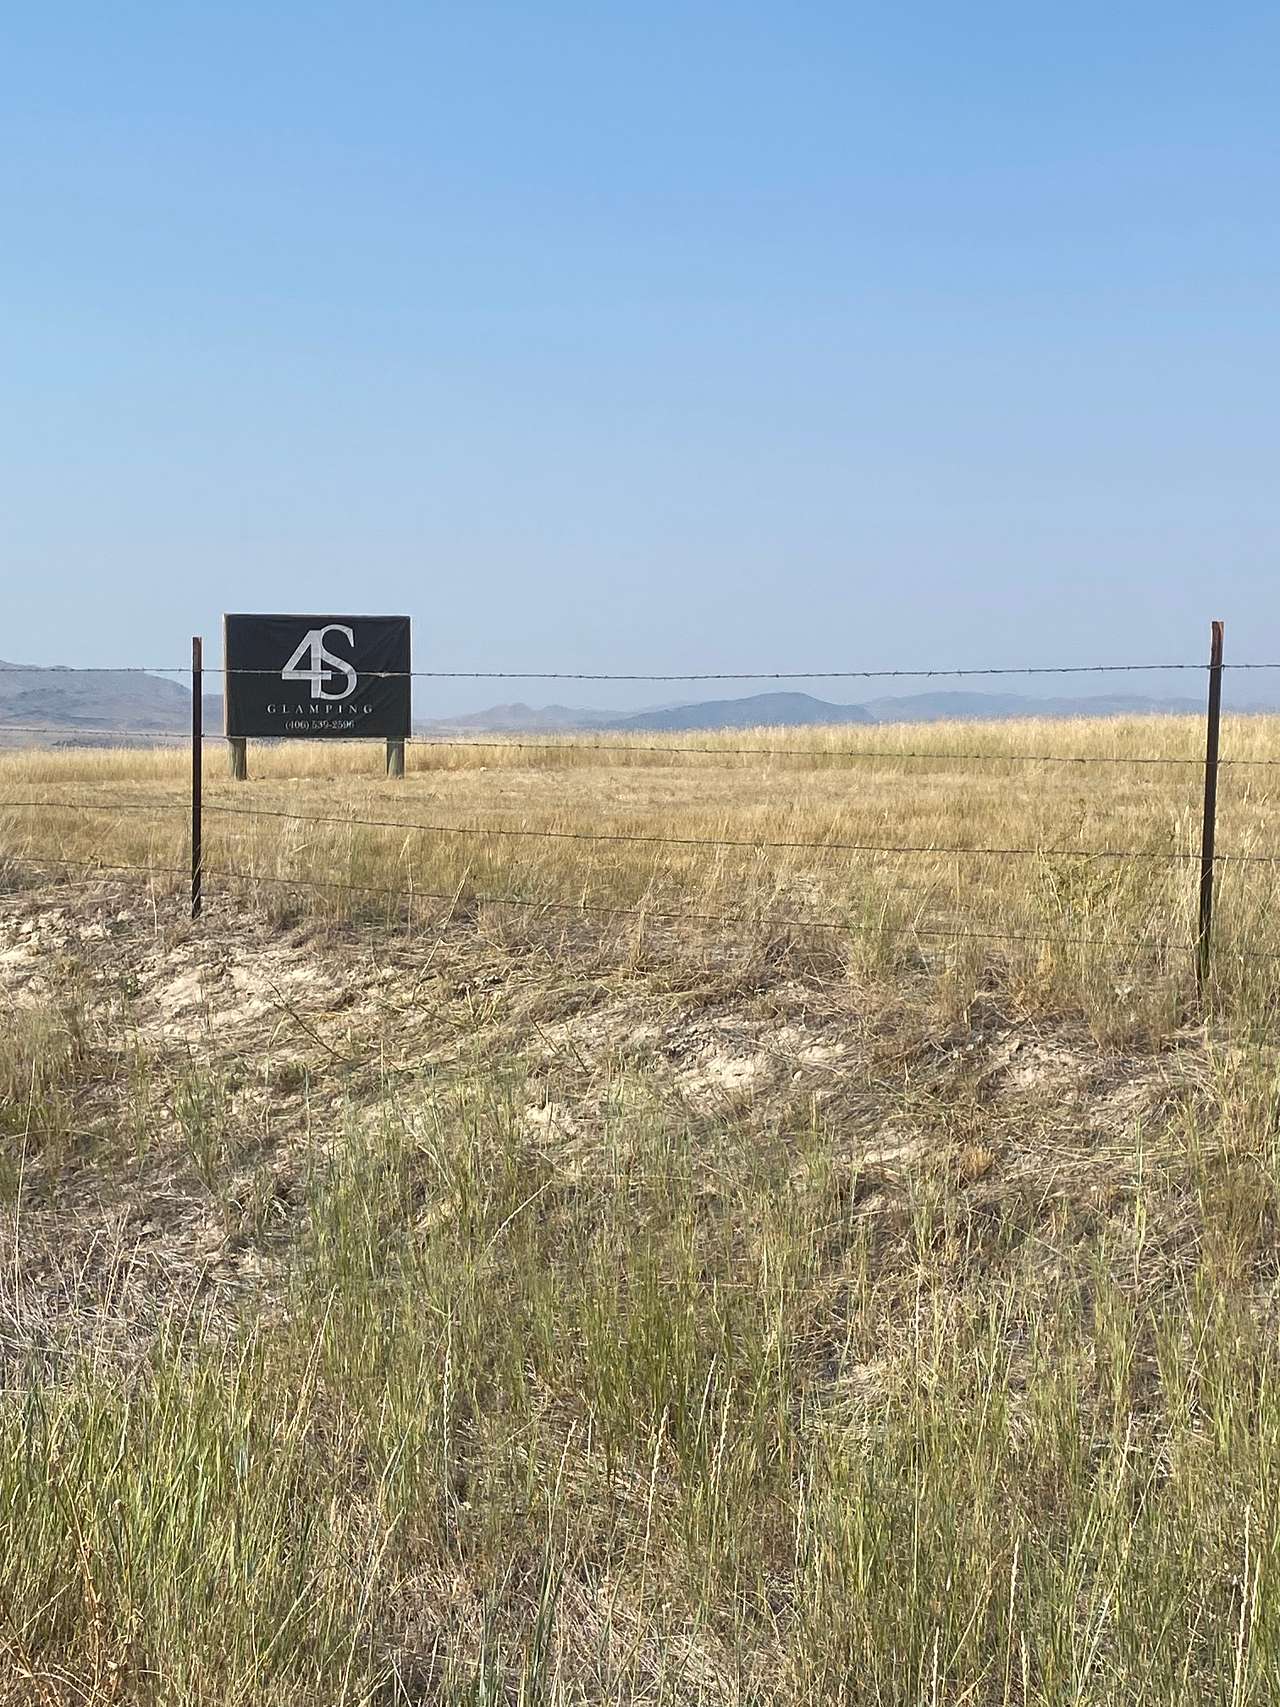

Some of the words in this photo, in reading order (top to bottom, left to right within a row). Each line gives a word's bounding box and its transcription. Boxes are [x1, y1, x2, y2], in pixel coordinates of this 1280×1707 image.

[281, 624, 358, 701] 4S
[267, 704, 373, 714] GLAMPING
[285, 719, 310, 730] (406)
